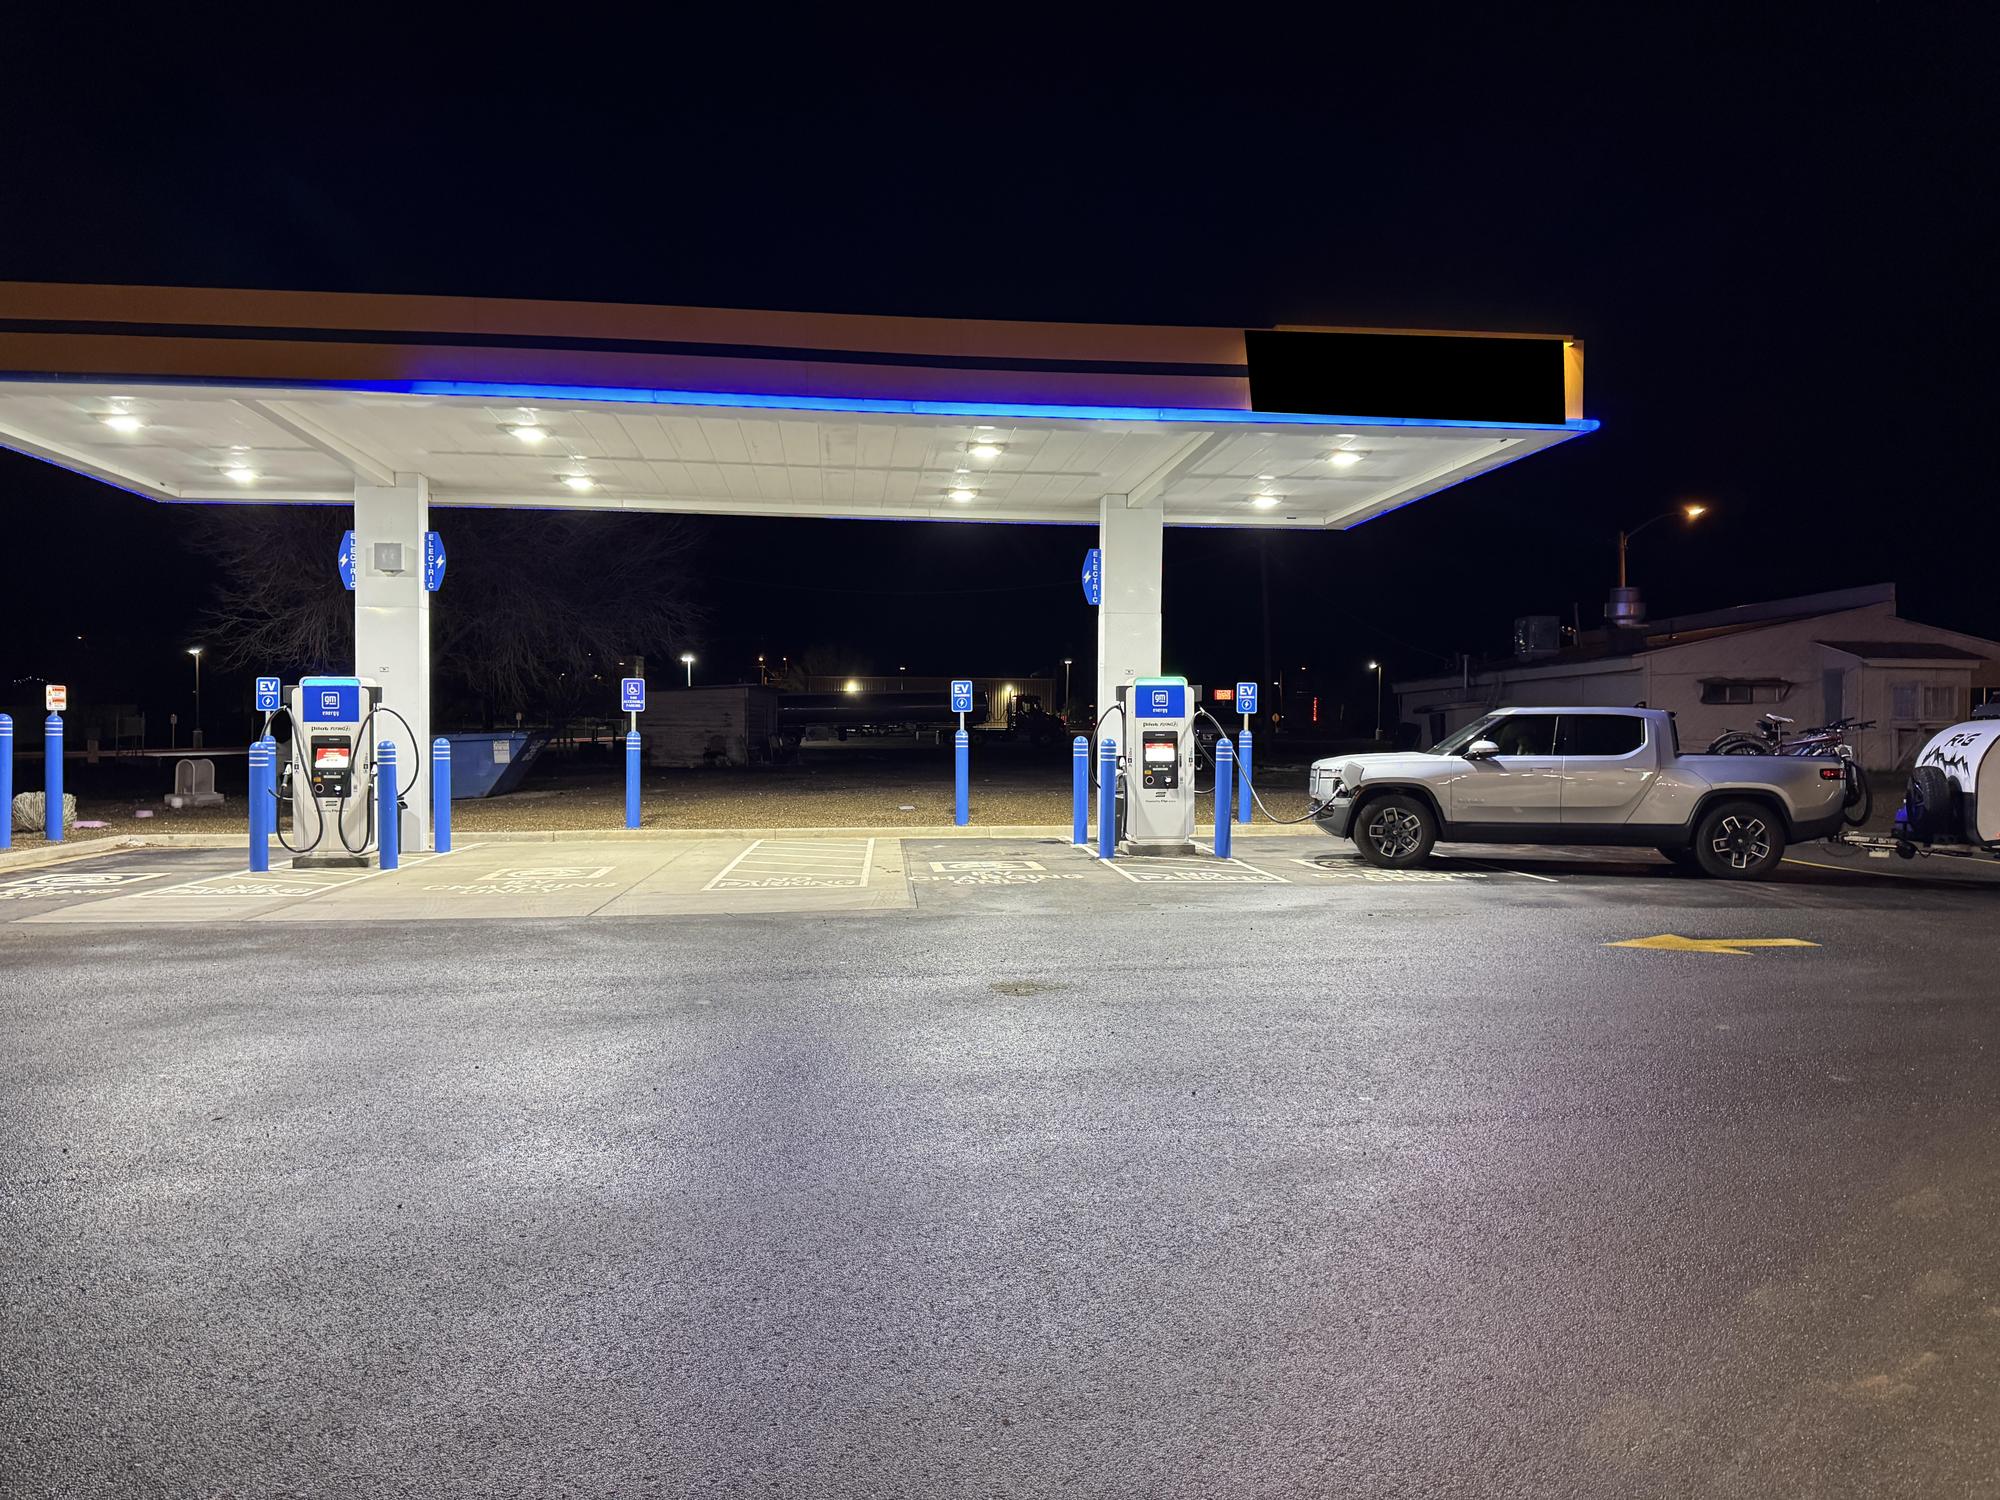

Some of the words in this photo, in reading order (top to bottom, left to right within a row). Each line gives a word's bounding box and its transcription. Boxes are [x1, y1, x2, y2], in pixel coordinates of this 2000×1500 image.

[259, 681, 276, 691] EV
[954, 684, 969, 693] EV
[1239, 686, 1254, 695] EV
[718, 879, 856, 888] PARKING
